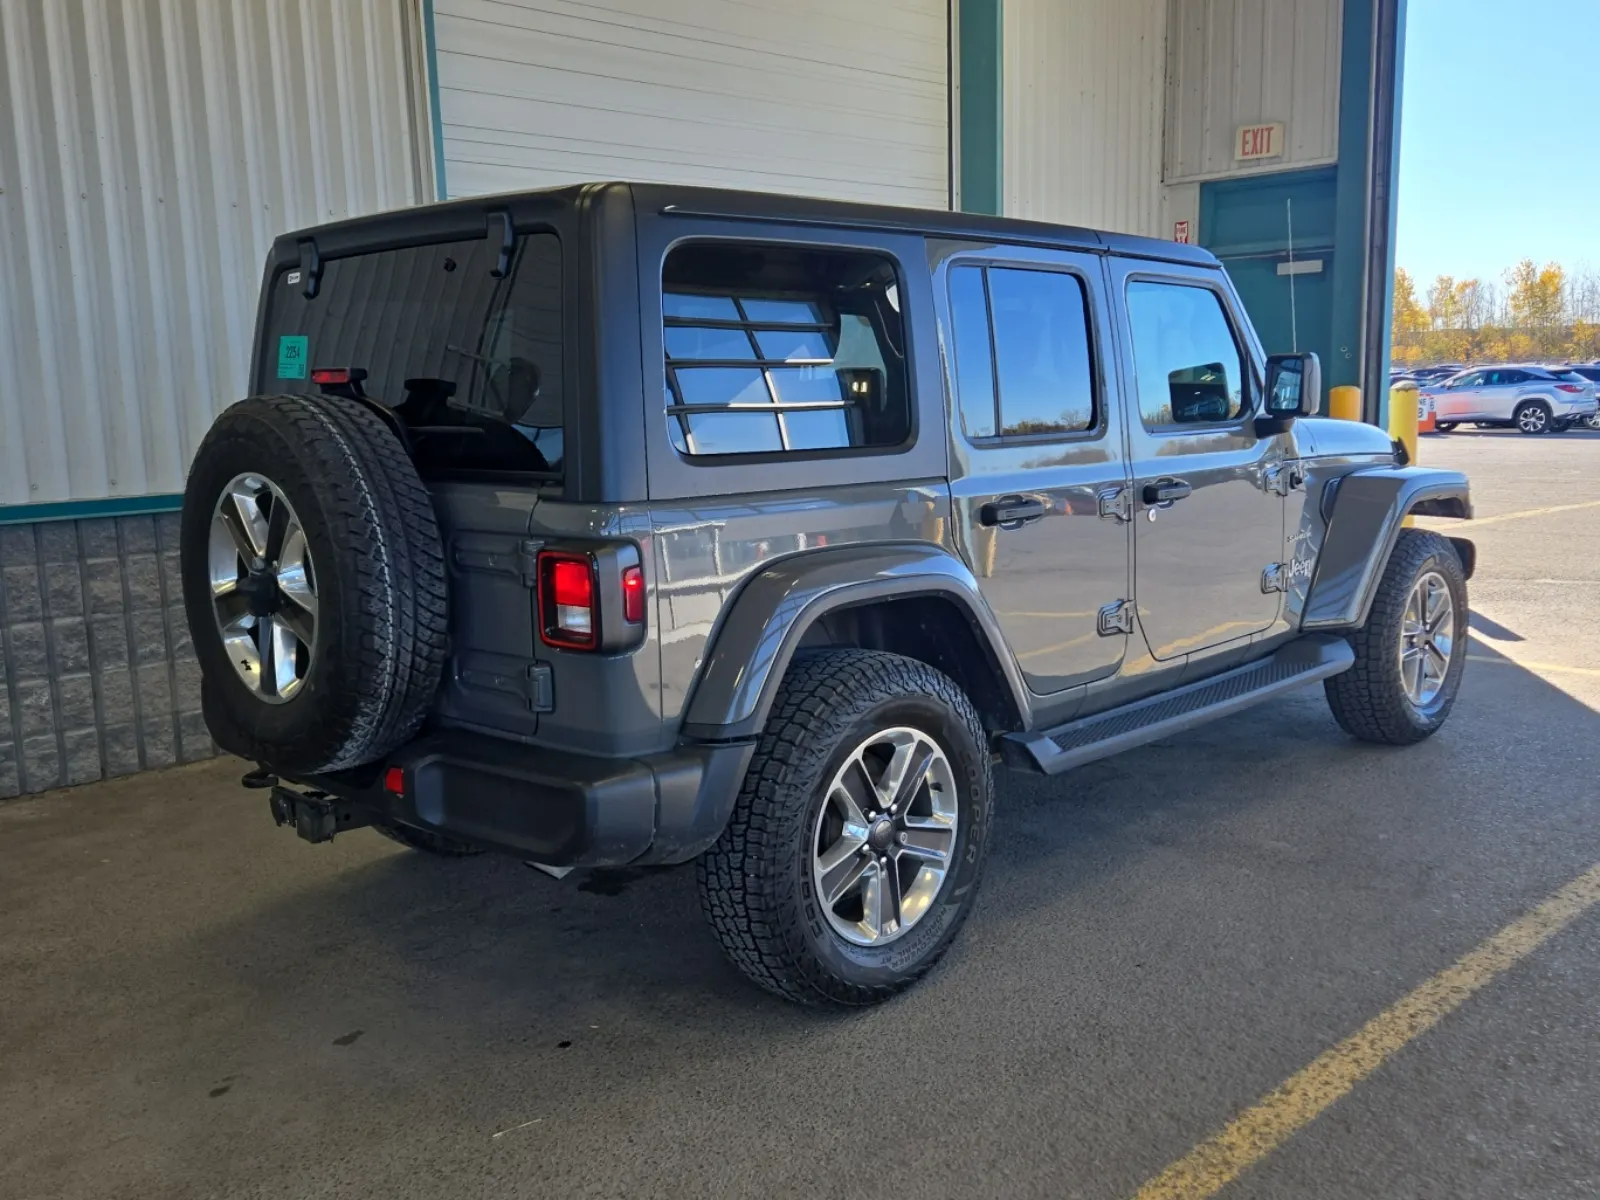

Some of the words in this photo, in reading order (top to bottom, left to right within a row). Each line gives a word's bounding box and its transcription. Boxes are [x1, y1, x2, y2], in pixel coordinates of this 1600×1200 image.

[1241, 126, 1274, 157] EXIT
[286, 345, 300, 360] 2254
[1288, 558, 1312, 578] Jeep
[958, 749, 981, 864] COOPER
